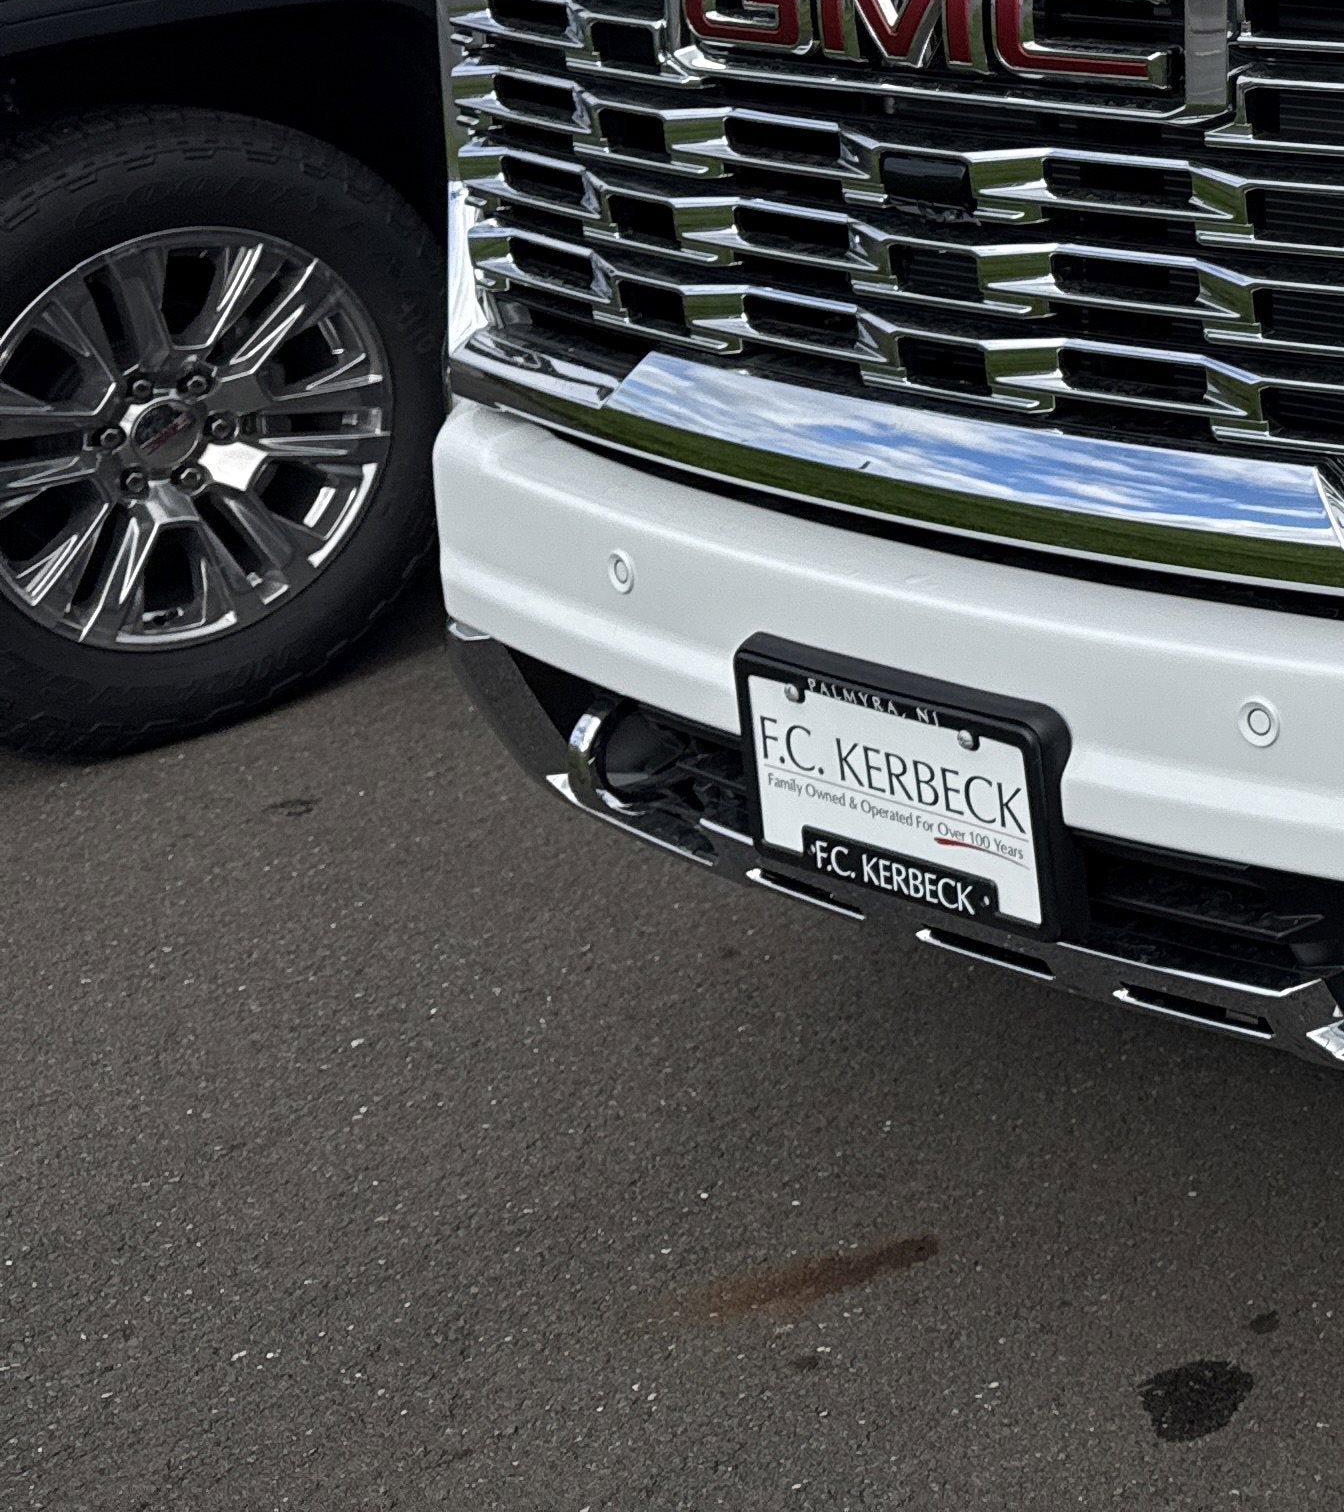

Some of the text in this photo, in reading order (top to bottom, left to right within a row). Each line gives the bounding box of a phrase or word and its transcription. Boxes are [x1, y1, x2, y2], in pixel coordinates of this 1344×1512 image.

[759, 714, 1027, 835] F.C. KERBECK
[767, 772, 1024, 860] Family Owned & Operated For Over 100 Years
[815, 840, 975, 916] F.C. KERBECK
